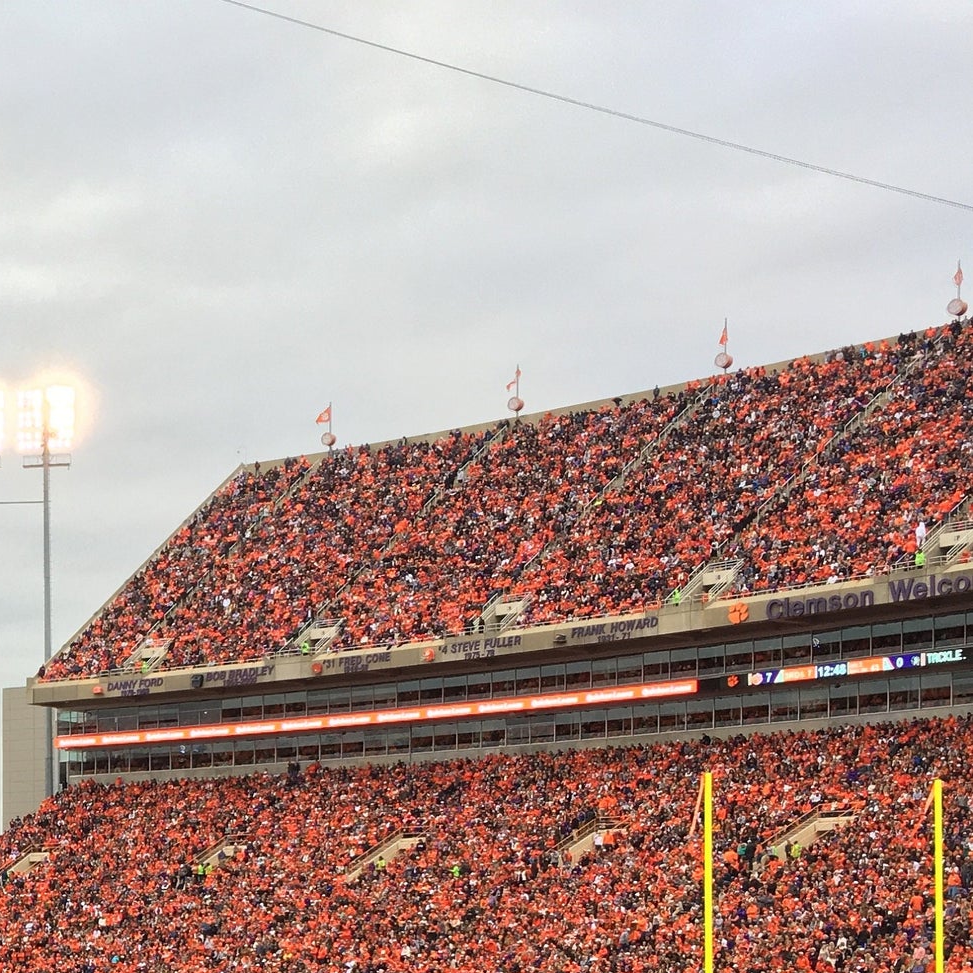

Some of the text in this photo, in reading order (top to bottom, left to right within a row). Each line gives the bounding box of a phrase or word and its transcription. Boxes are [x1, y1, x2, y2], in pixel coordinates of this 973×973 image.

[766, 575, 973, 620] Clemson Welco
[571, 616, 659, 638] FRANK HOWARD
[450, 640, 481, 653] STEVE
[484, 636, 522, 649] FULLER
[338, 655, 364, 667] FRED
[366, 652, 391, 664] CONE
[896, 657, 903, 668] 0
[927, 649, 967, 664] TACKLE.
[206, 665, 275, 681] BOB BRADLEY
[818, 663, 847, 677] 12:48
[107, 677, 164, 692] DANNY FORD
